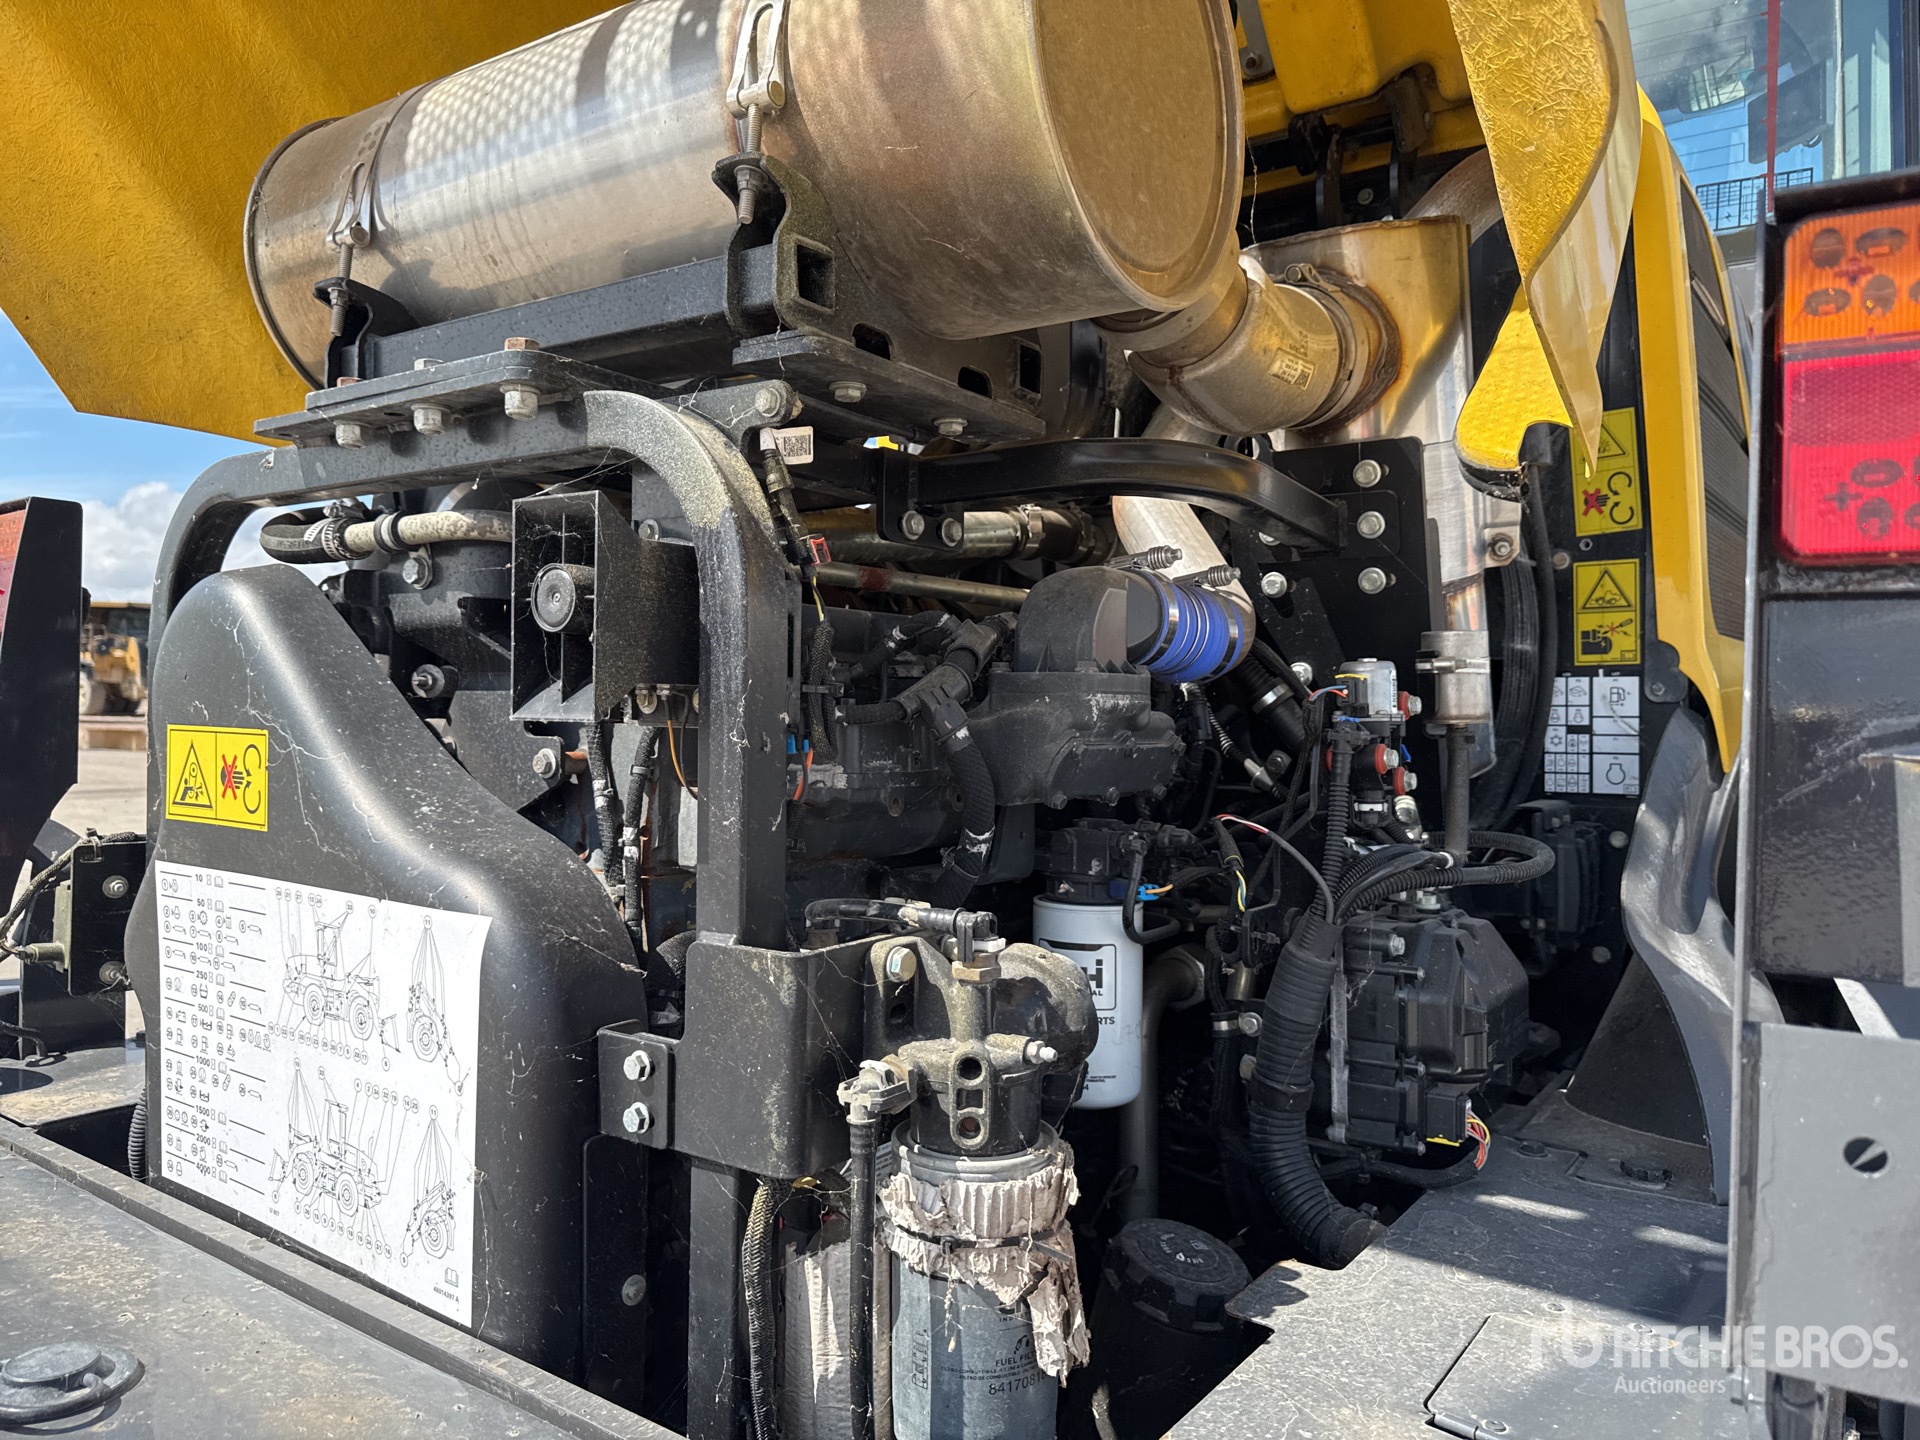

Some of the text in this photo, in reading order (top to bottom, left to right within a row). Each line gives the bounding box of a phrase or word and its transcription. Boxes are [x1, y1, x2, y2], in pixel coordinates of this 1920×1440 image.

[195, 873, 203, 883] 10
[196, 898, 205, 908] 50
[196, 942, 208, 952] 100
[196, 970, 208, 981] 250
[197, 1003, 209, 1014] 500
[1097, 1016, 1115, 1025] RTS
[195, 1055, 211, 1067] 1000
[195, 1104, 210, 1117] 1500
[196, 1133, 211, 1146] 2000
[995, 1356, 1018, 1367] FUEL
[1019, 1350, 1036, 1362] FILT
